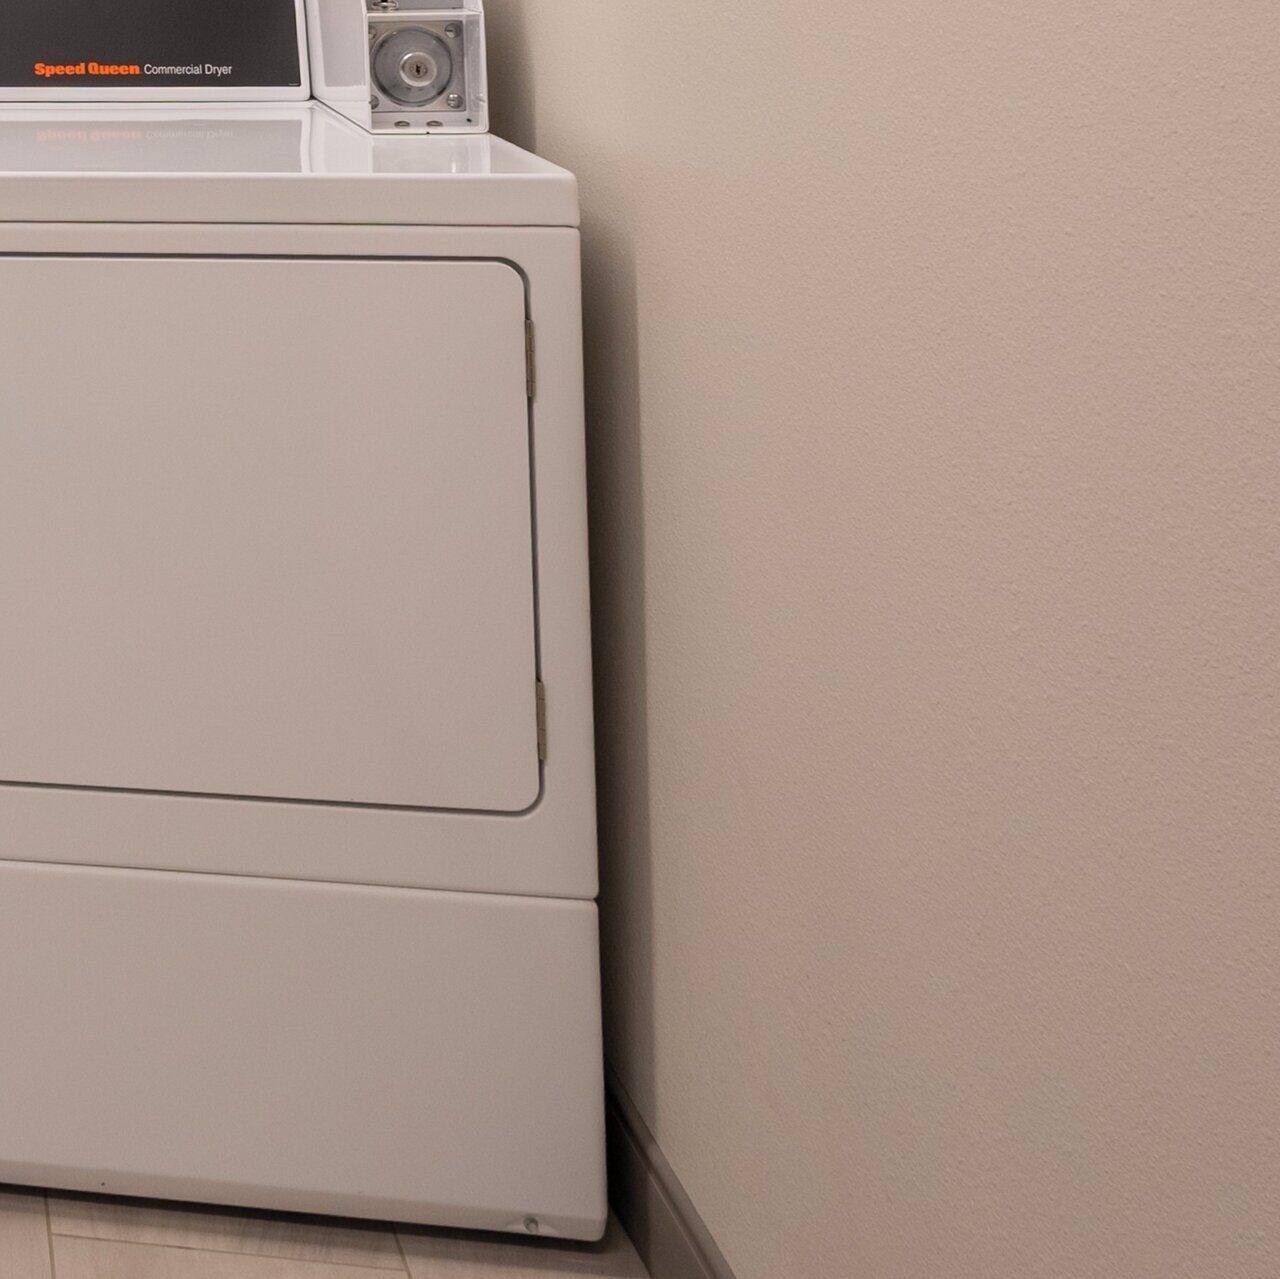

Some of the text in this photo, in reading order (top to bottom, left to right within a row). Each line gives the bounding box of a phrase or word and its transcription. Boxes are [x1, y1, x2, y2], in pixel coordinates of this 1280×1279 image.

[34, 62, 232, 78] Speed Queen Commercial Dryer
